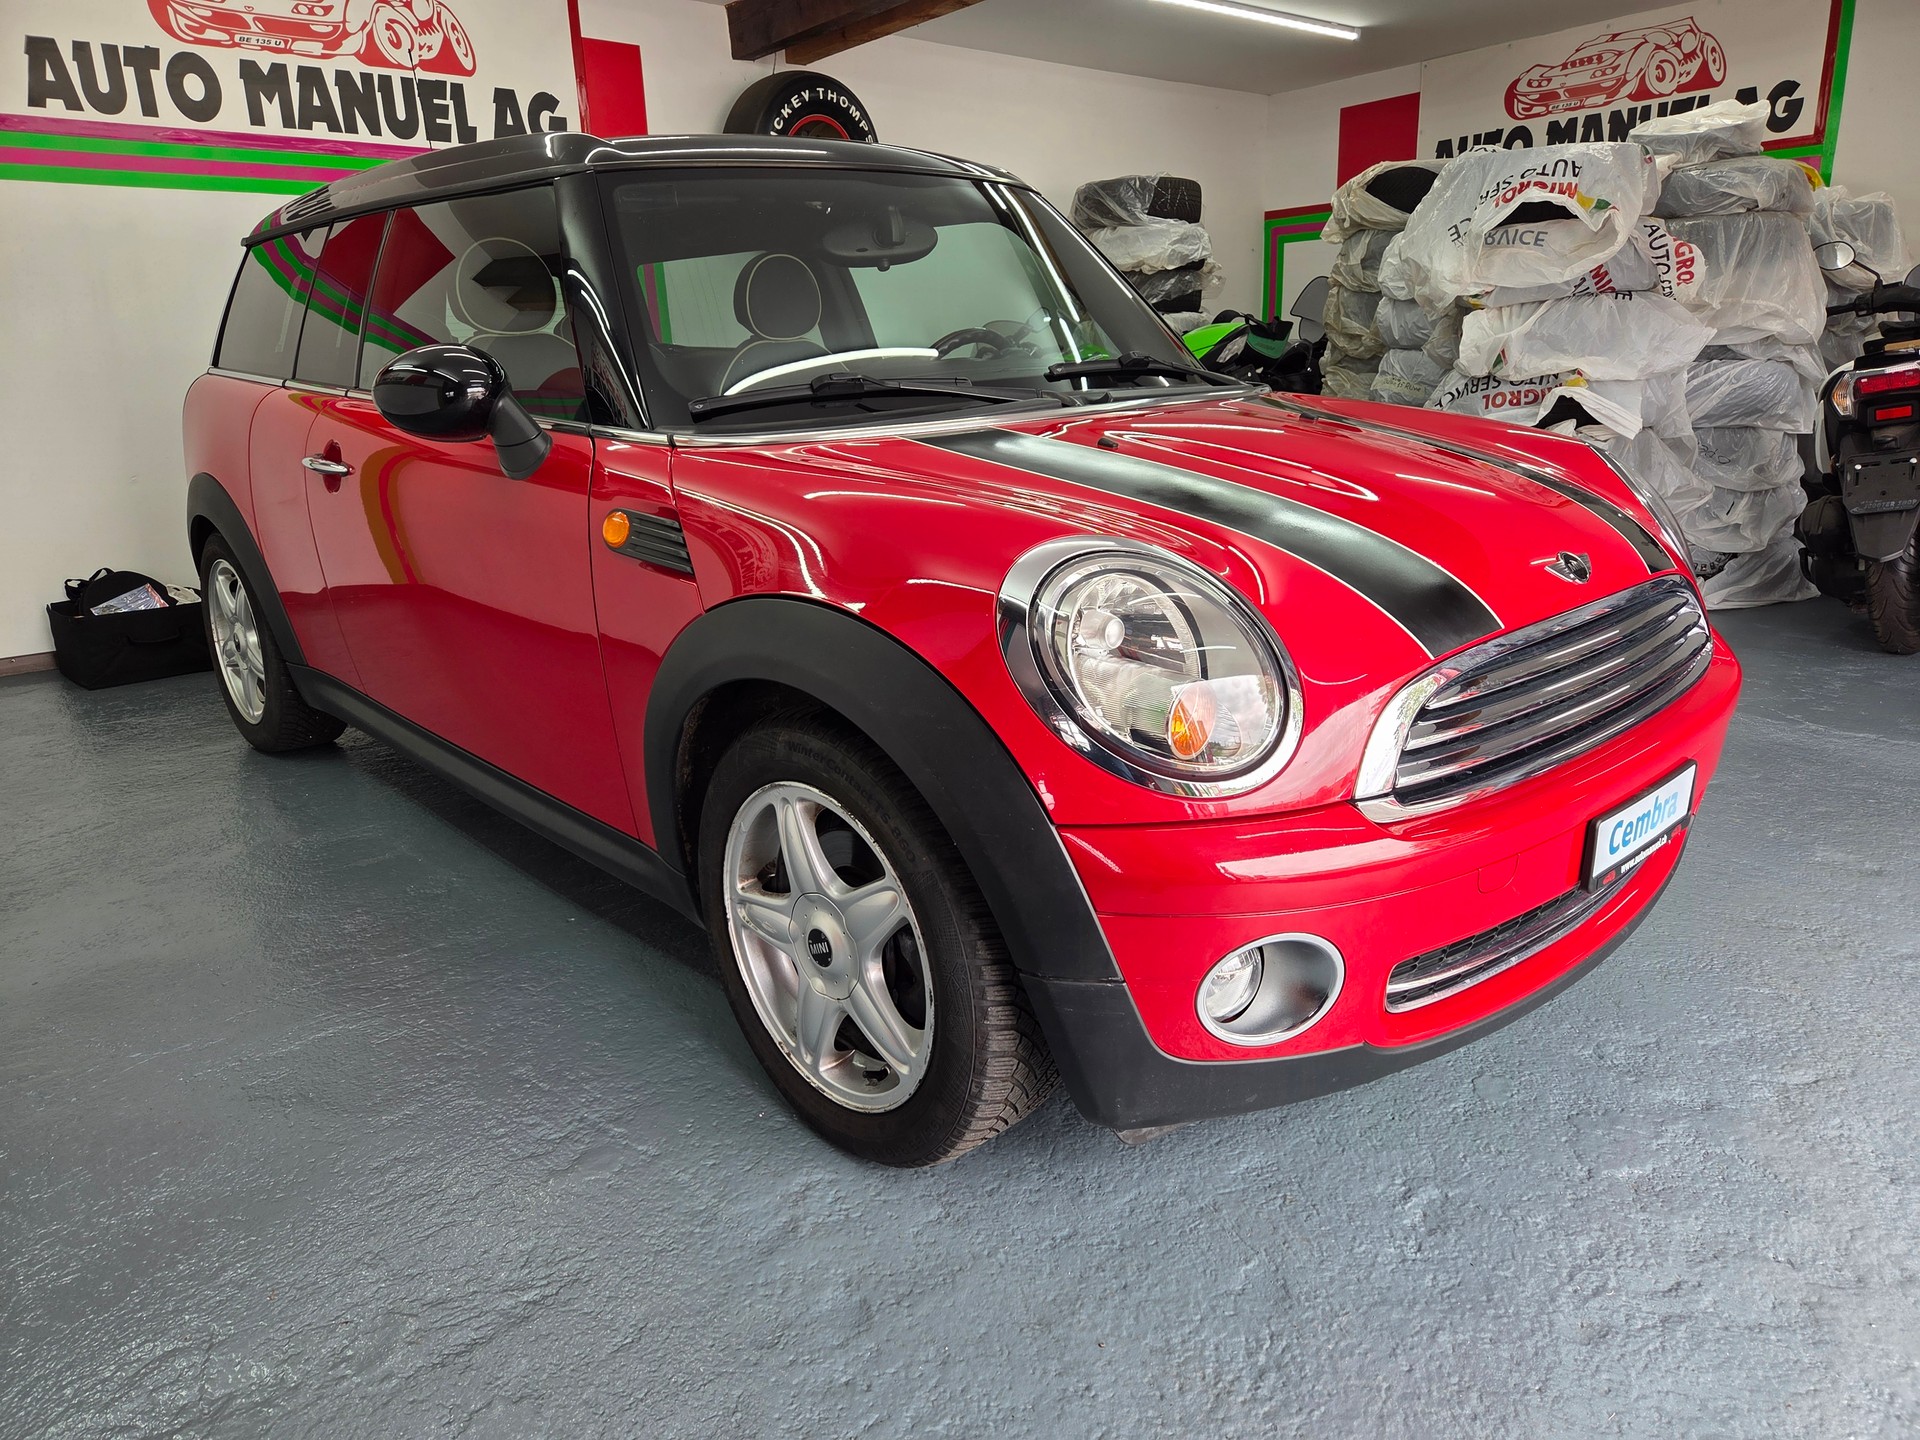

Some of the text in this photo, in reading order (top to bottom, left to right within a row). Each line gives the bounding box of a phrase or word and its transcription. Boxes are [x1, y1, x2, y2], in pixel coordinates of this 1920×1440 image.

[24, 35, 567, 145] AUTO MANUEL AG
[770, 87, 874, 144] CKEY THOMPS
[1546, 94, 1711, 146] MAN
[1520, 158, 1582, 180] AUTO
[1609, 792, 1679, 856] Cembra
[809, 941, 829, 955] MINI
